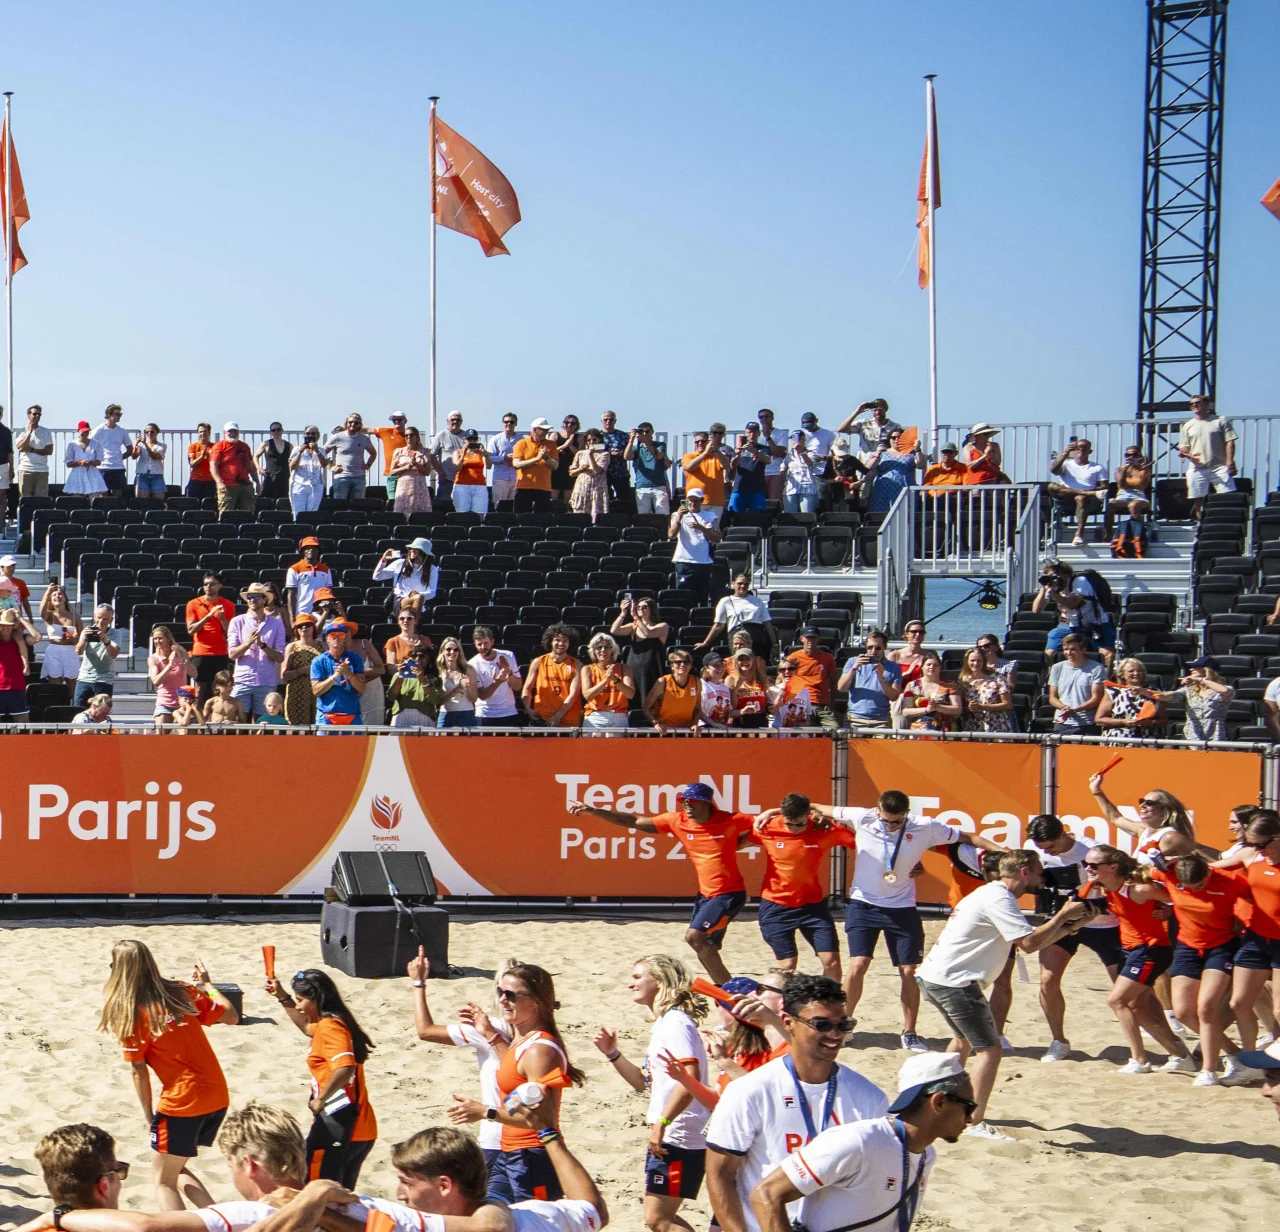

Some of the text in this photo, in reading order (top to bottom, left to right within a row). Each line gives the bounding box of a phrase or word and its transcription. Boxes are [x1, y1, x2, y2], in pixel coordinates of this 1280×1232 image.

[470, 178, 506, 208] Host city
[28, 781, 217, 859] Parijs
[560, 828, 656, 860] Paris
